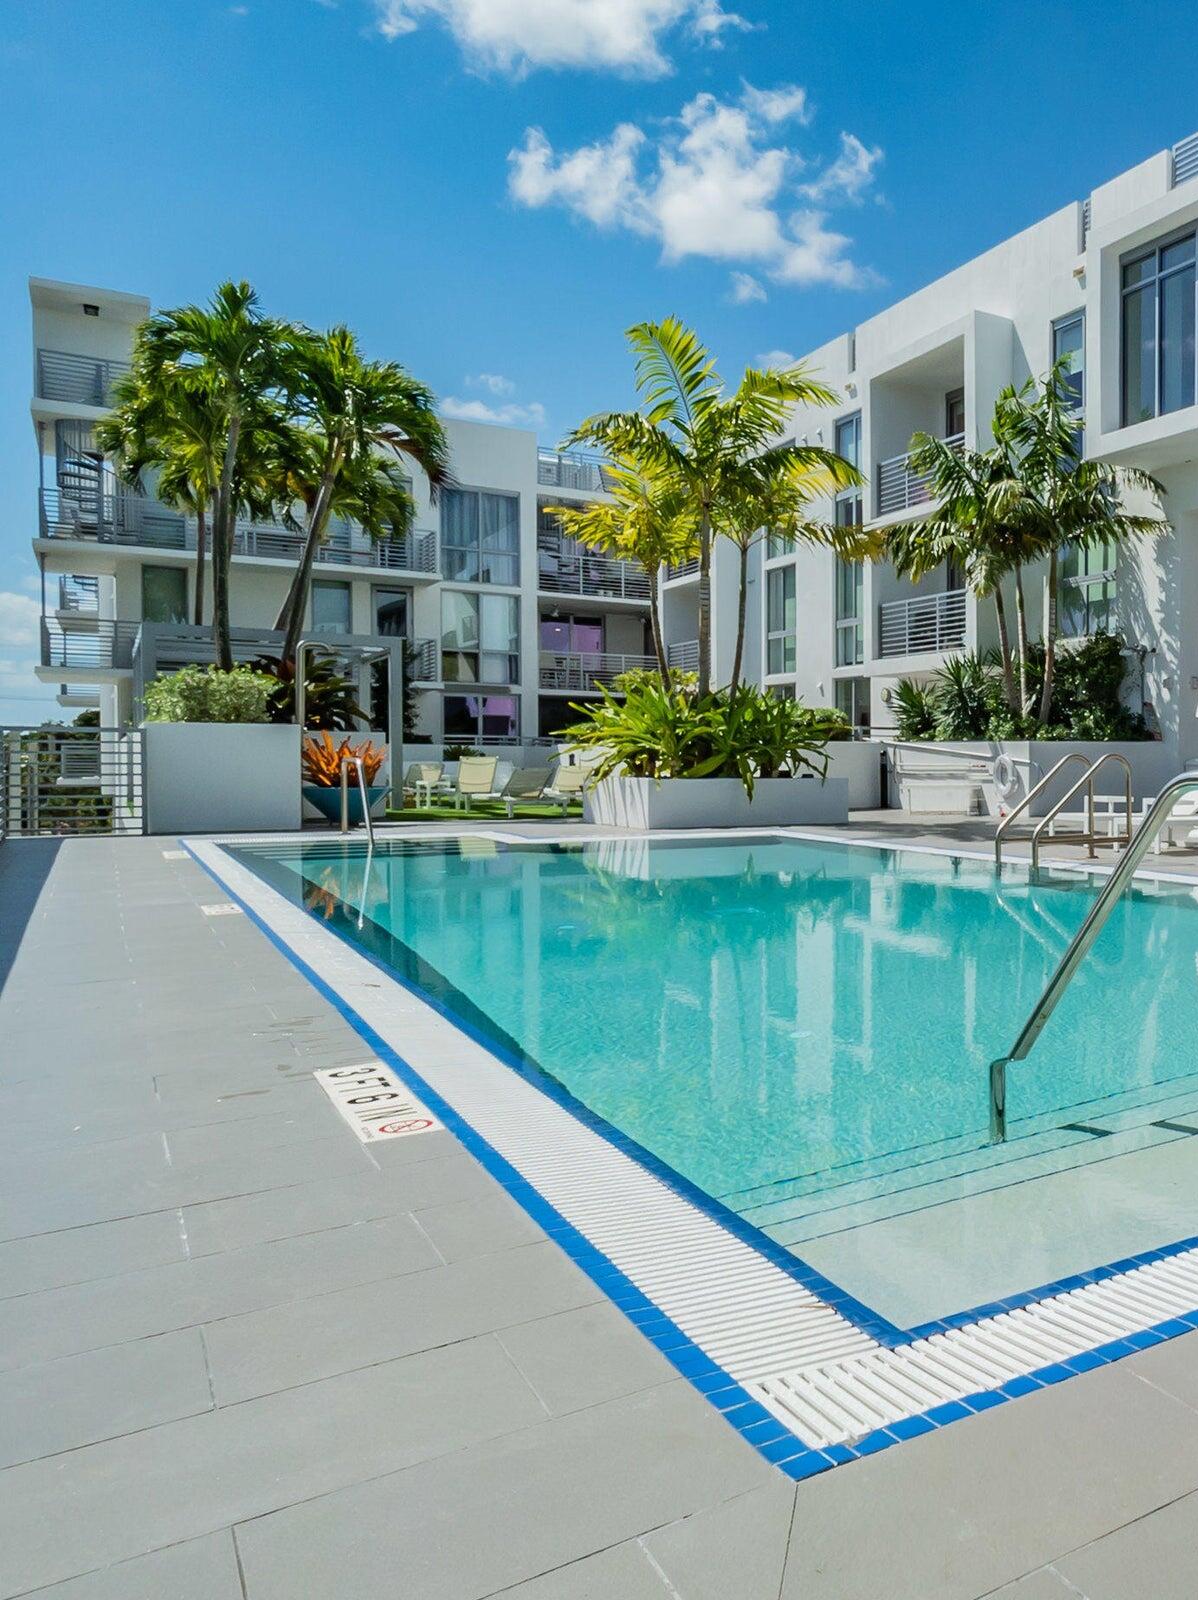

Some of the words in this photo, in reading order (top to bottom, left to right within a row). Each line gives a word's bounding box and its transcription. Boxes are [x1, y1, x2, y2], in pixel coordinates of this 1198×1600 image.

[329, 1067, 377, 1078] 3
[334, 1077, 392, 1093] FT
[347, 1092, 400, 1105] 6
[355, 1104, 417, 1122] IN
